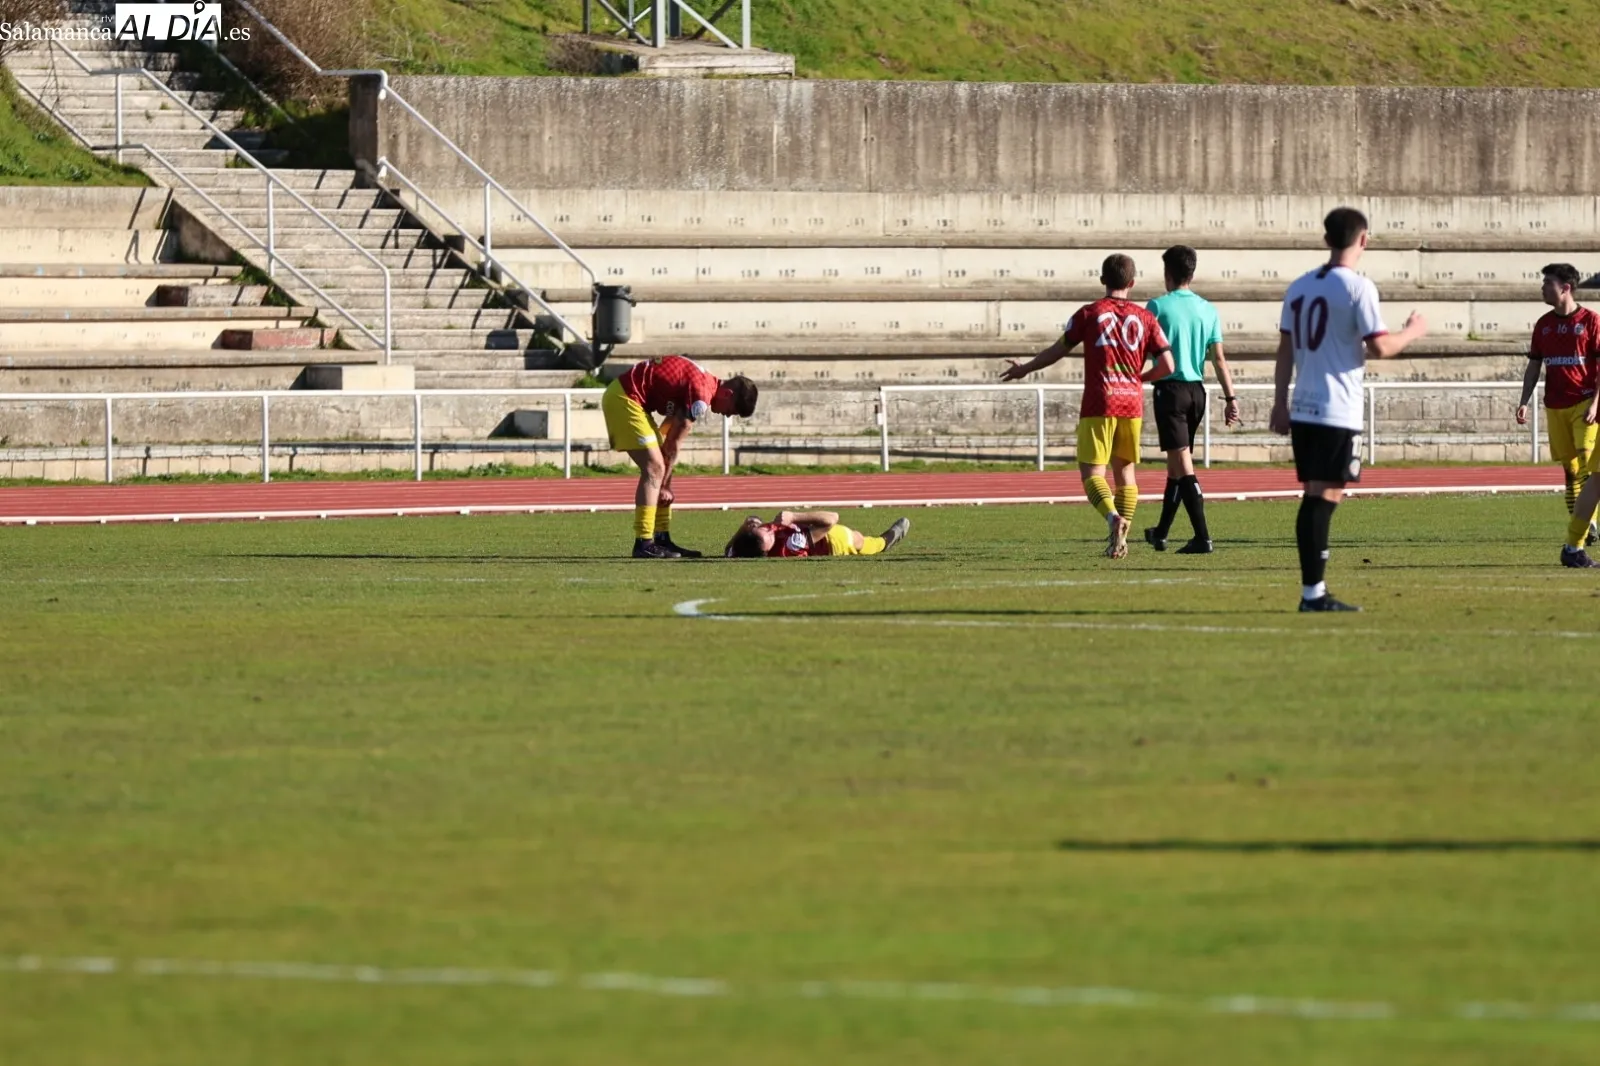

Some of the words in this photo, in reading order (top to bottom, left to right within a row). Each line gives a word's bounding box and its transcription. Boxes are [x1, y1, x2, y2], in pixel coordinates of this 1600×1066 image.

[1095, 311, 1144, 351] 20
[1290, 294, 1329, 352] 10
[1557, 323, 1568, 334] 16
